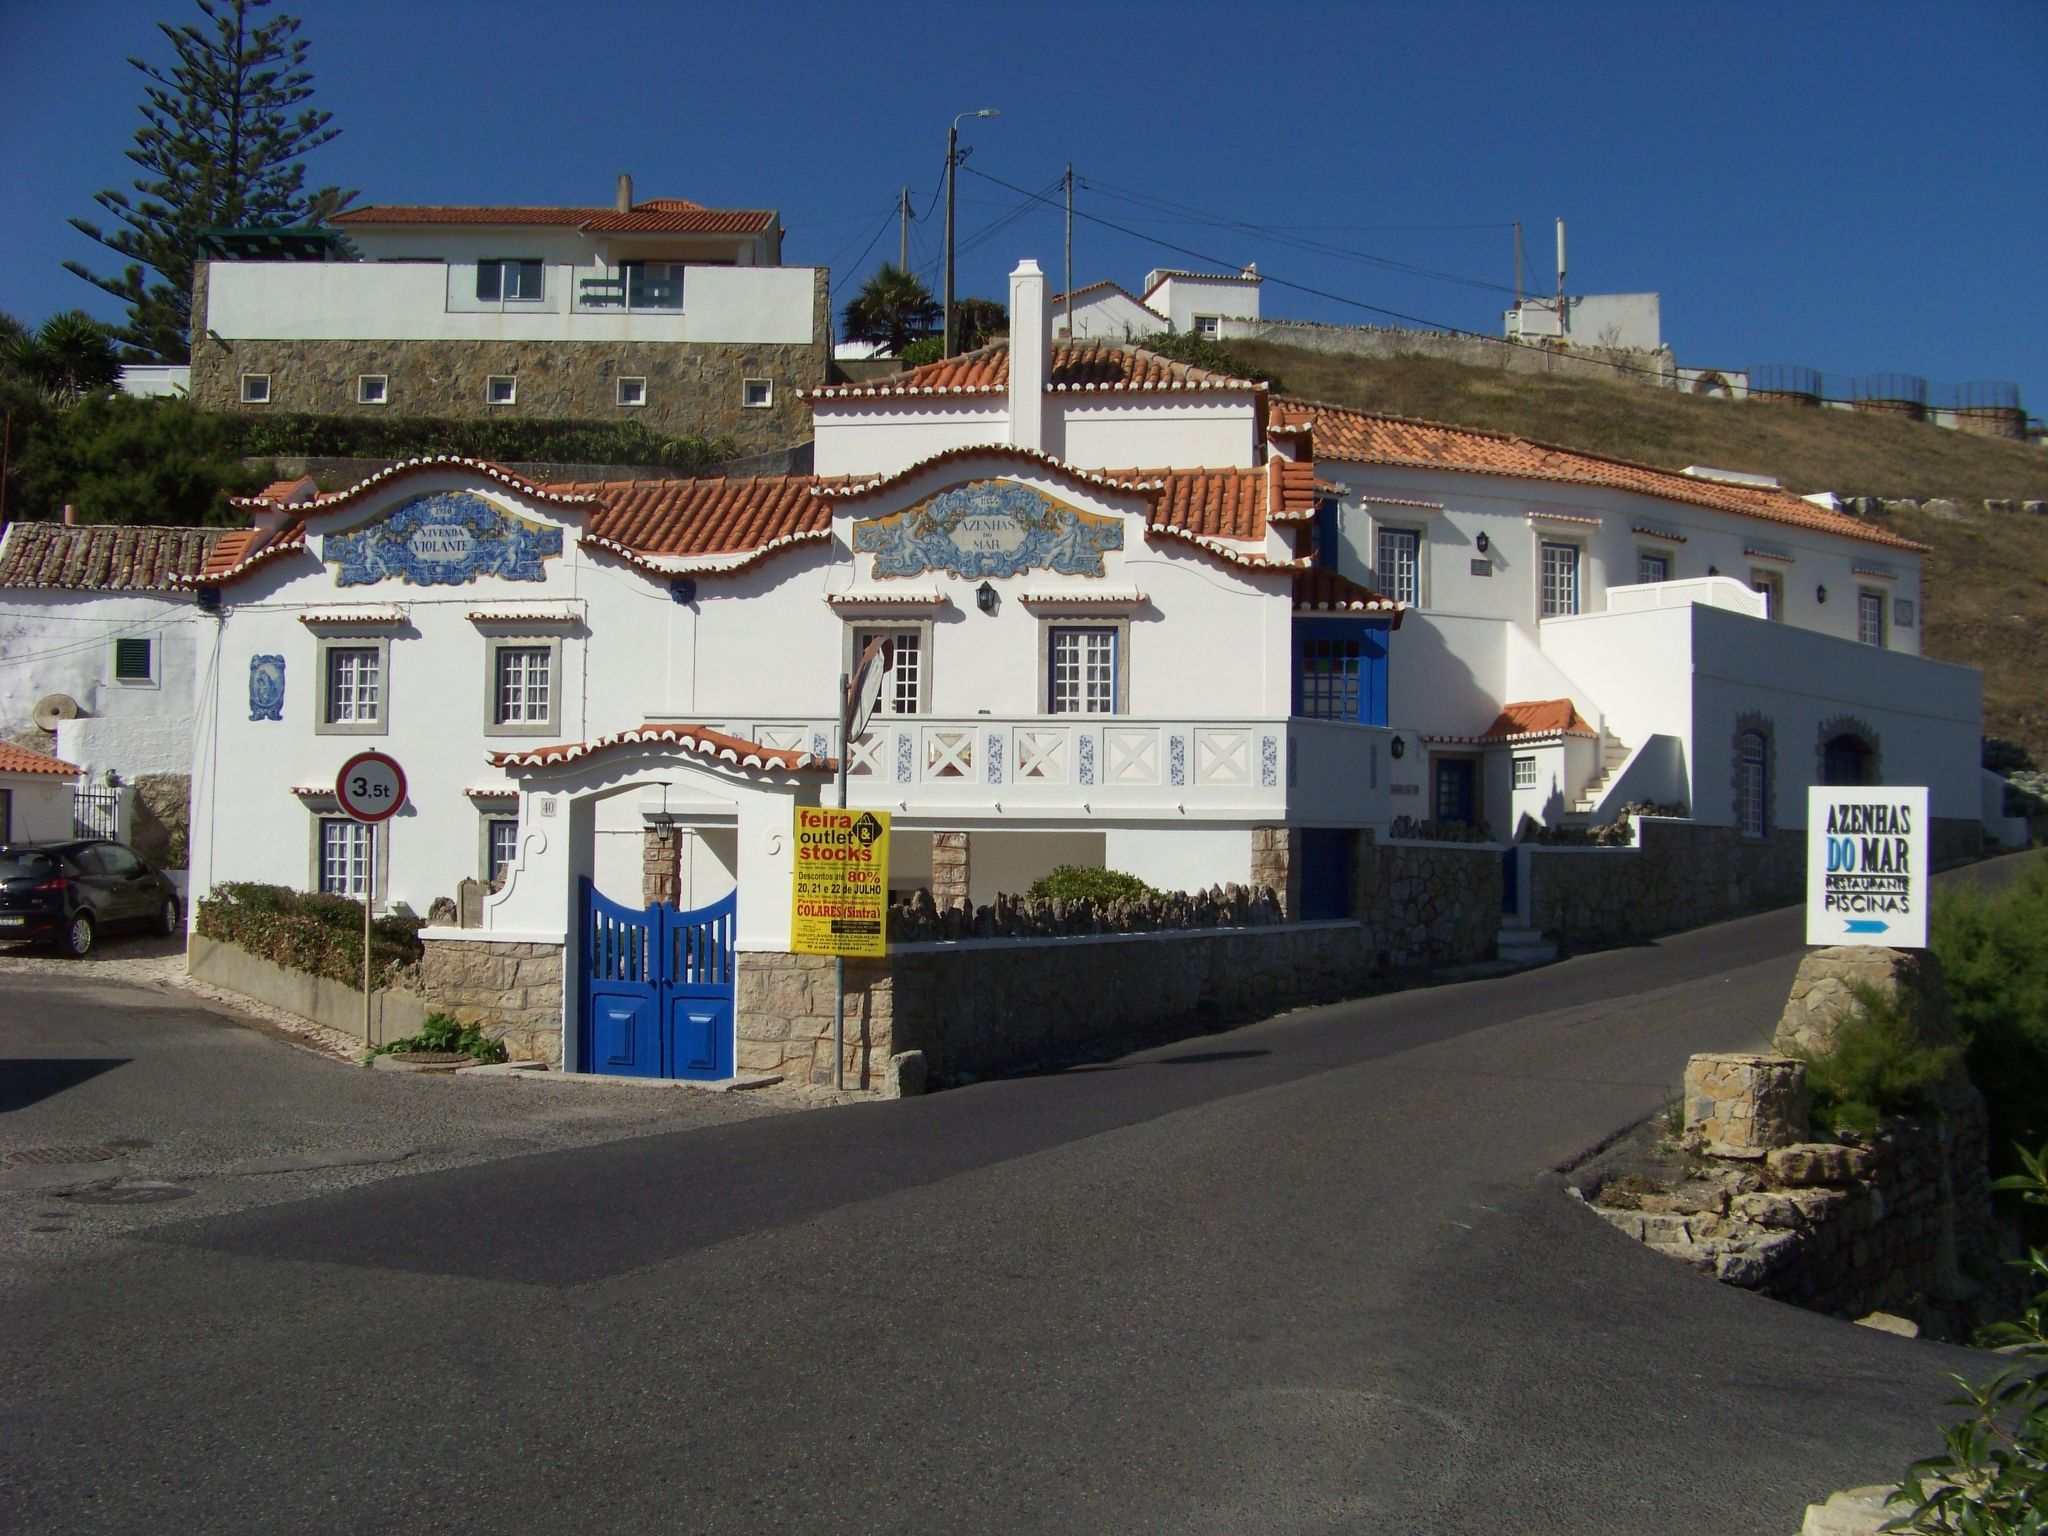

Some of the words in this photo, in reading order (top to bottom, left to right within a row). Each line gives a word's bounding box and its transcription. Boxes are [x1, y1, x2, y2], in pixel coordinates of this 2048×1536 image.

[963, 520, 1015, 531] AZENHAS
[421, 528, 464, 537] VIVENDA
[413, 540, 469, 552] VIOLANTE
[974, 539, 1000, 550] MAR
[352, 776, 390, 799] 3,5t
[542, 801, 554, 813] 40
[800, 810, 852, 828] feira
[1826, 804, 1911, 834] AZENHAS
[800, 830, 853, 844] outlet
[800, 844, 872, 862] stocks
[1826, 836, 1855, 872] DO
[1860, 837, 1910, 873] MAR
[799, 872, 833, 880] Descontos
[834, 872, 844, 881] até
[848, 871, 880, 884] 80%
[1825, 876, 1909, 891] RESTAURANTE
[798, 883, 809, 894] 20,
[812, 883, 821, 893] 21
[831, 884, 840, 894] 22
[843, 885, 852, 894] de
[854, 885, 881, 895] JULHO
[1825, 894, 1910, 914] PISCINAS
[797, 905, 841, 918] COLARES
[844, 906, 880, 918] (Sintra)
